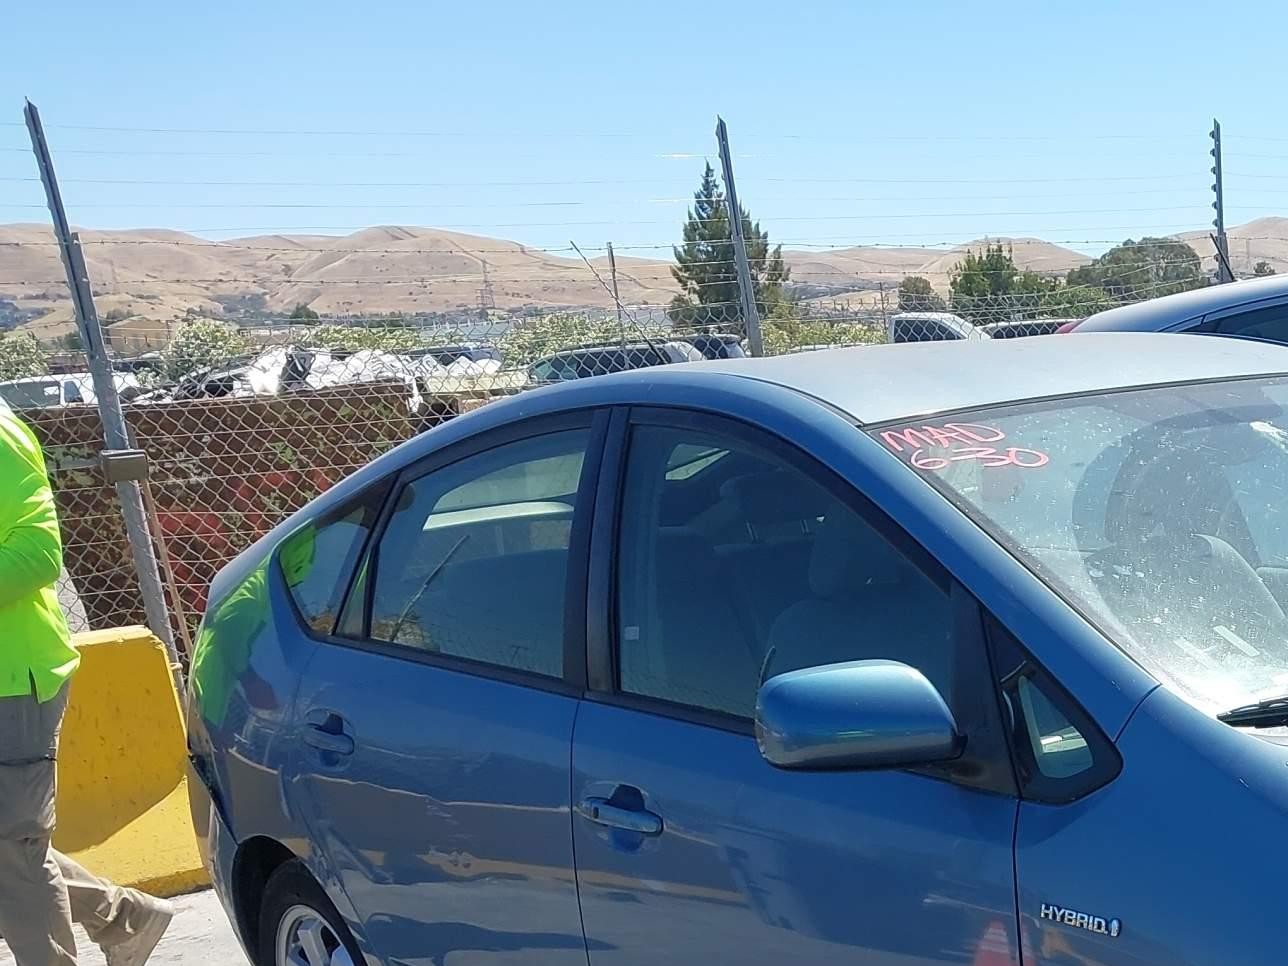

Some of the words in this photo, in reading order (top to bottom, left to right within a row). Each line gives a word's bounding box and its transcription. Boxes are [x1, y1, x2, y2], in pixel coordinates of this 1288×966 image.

[880, 423, 1005, 450] MAD
[910, 448, 1049, 469] 6-30
[1040, 903, 1107, 934] HYBRID
